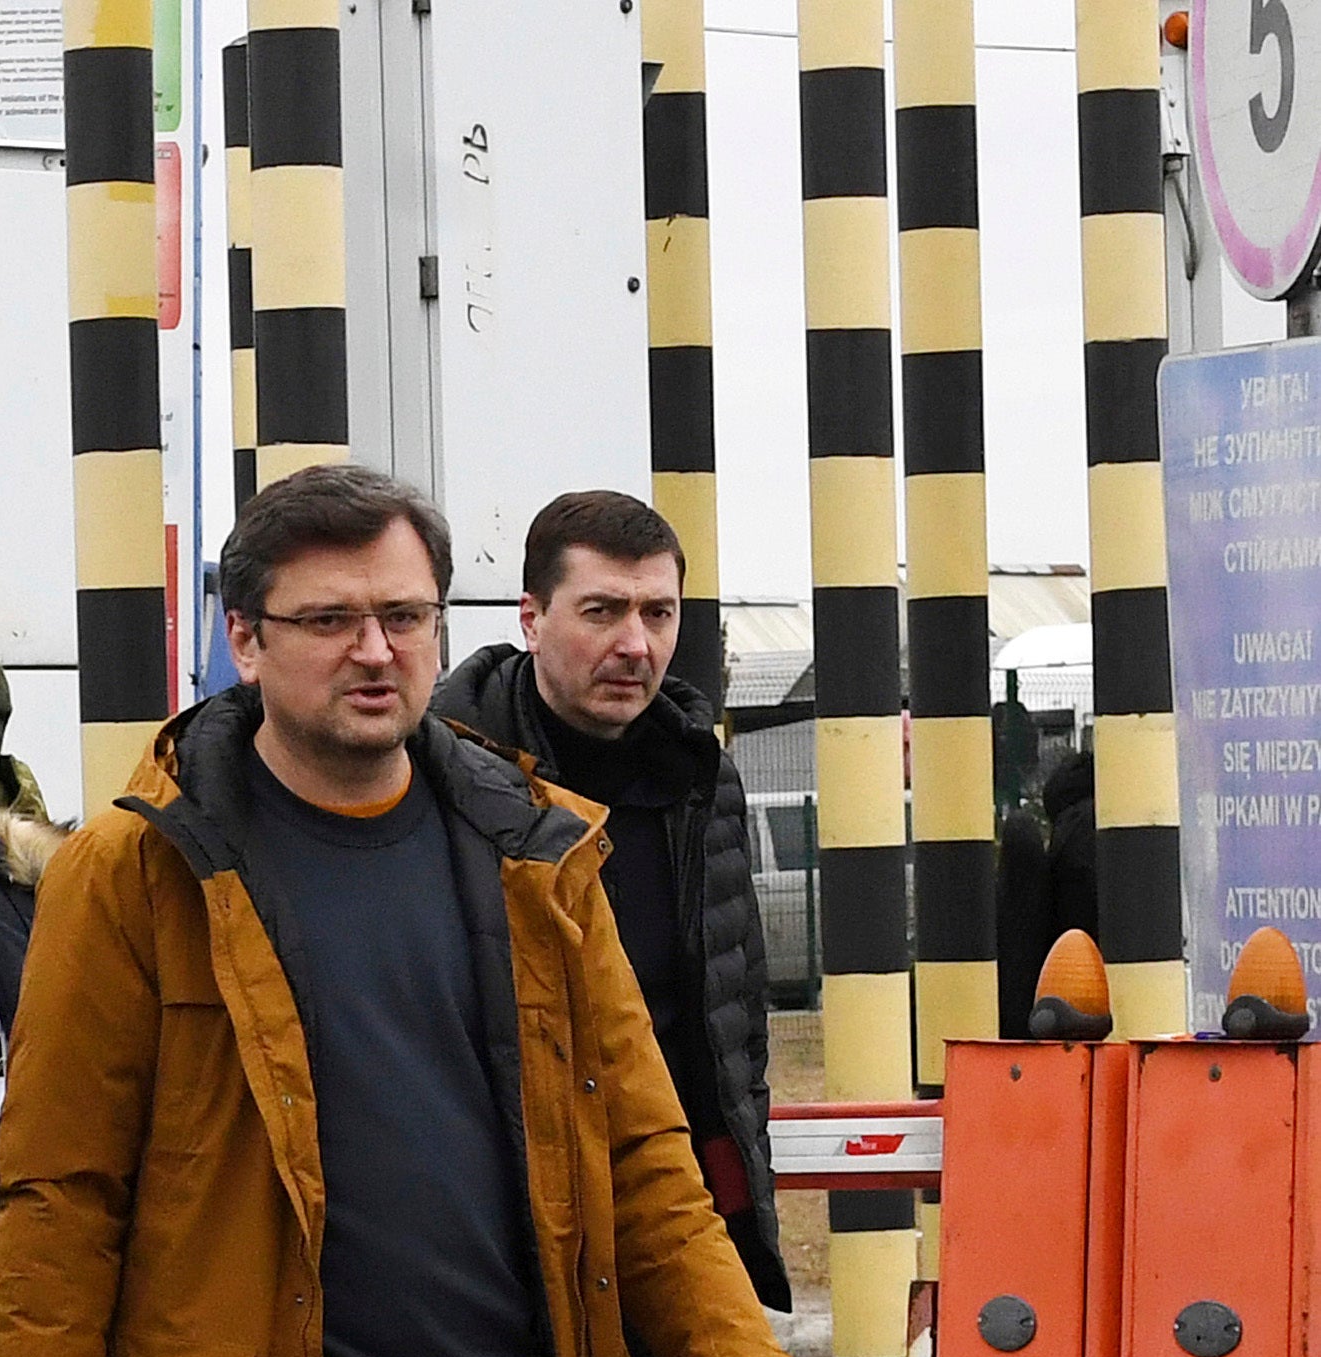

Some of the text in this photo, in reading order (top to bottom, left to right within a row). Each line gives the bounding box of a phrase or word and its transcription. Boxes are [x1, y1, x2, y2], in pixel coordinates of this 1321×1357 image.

[1194, 435, 1218, 468] НЕ
[1234, 629, 1312, 664] UWAGA!
[1221, 684, 1321, 718] ZATRZYMY
[1224, 741, 1251, 780] SIĘ
[1284, 795, 1302, 826] W
[1225, 886, 1321, 919] ATTENTION
